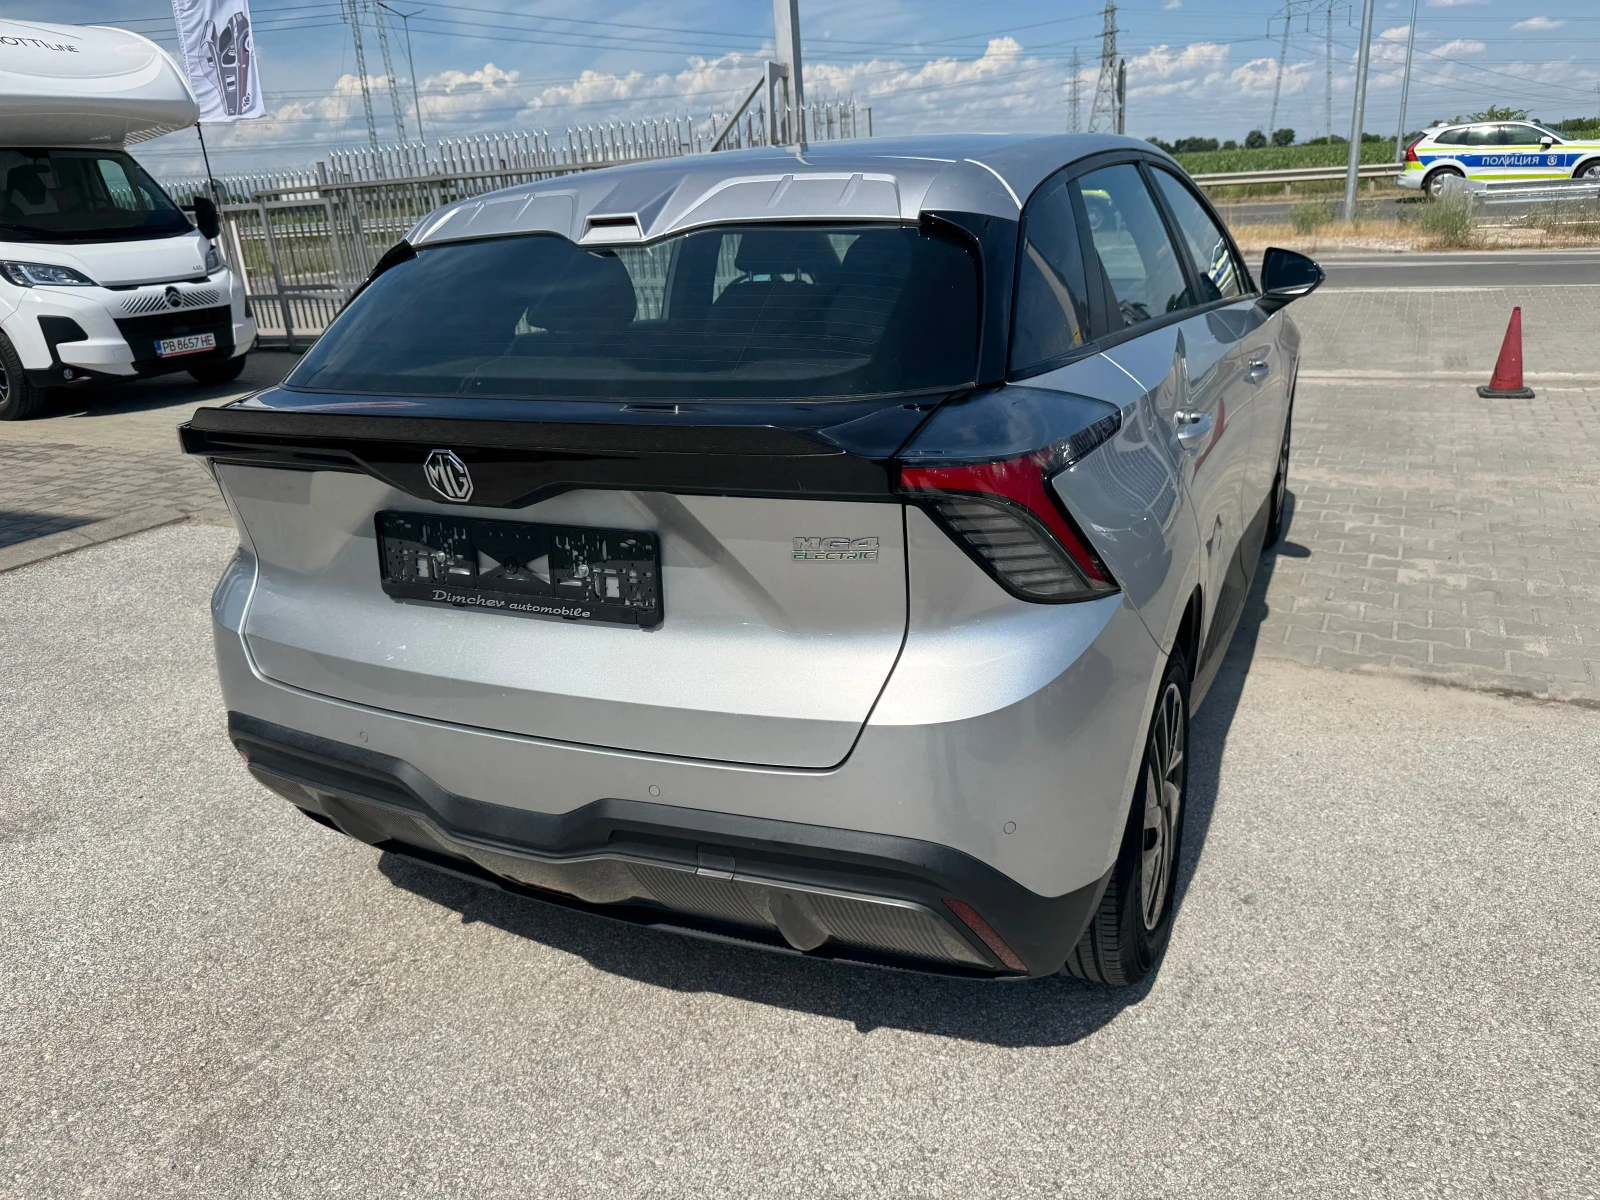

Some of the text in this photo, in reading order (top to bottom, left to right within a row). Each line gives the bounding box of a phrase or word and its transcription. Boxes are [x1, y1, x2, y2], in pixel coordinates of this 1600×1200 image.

[1481, 156, 1540, 166] ПОЛИЦИЯ
[162, 335, 214, 353] PB 8657 HE
[426, 452, 471, 500] MG
[793, 537, 879, 550] MG4
[793, 551, 875, 560] ELECTRIC
[431, 589, 591, 618] Dimchev automobile
